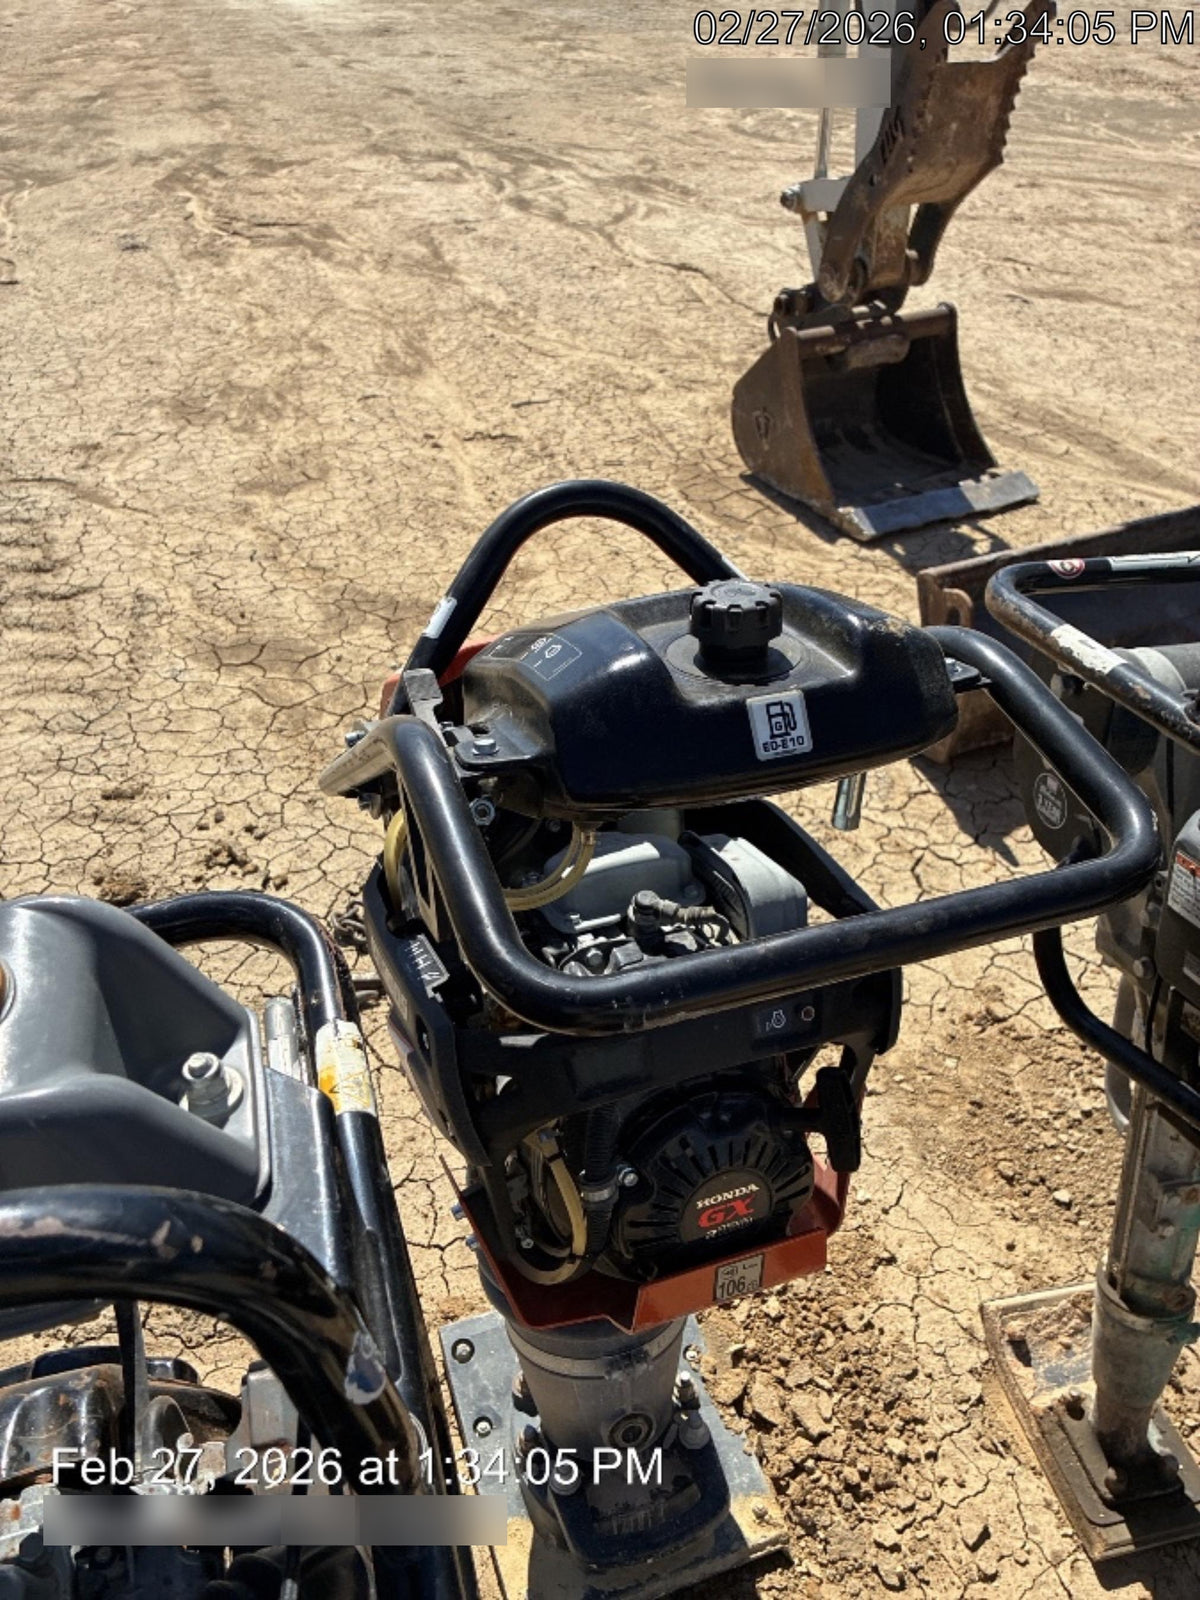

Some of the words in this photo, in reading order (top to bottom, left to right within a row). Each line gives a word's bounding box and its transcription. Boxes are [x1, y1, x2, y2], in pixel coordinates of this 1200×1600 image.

[696, 1184, 760, 1209] HONDA
[698, 1196, 754, 1227] GX
[719, 1277, 745, 1298] 106
